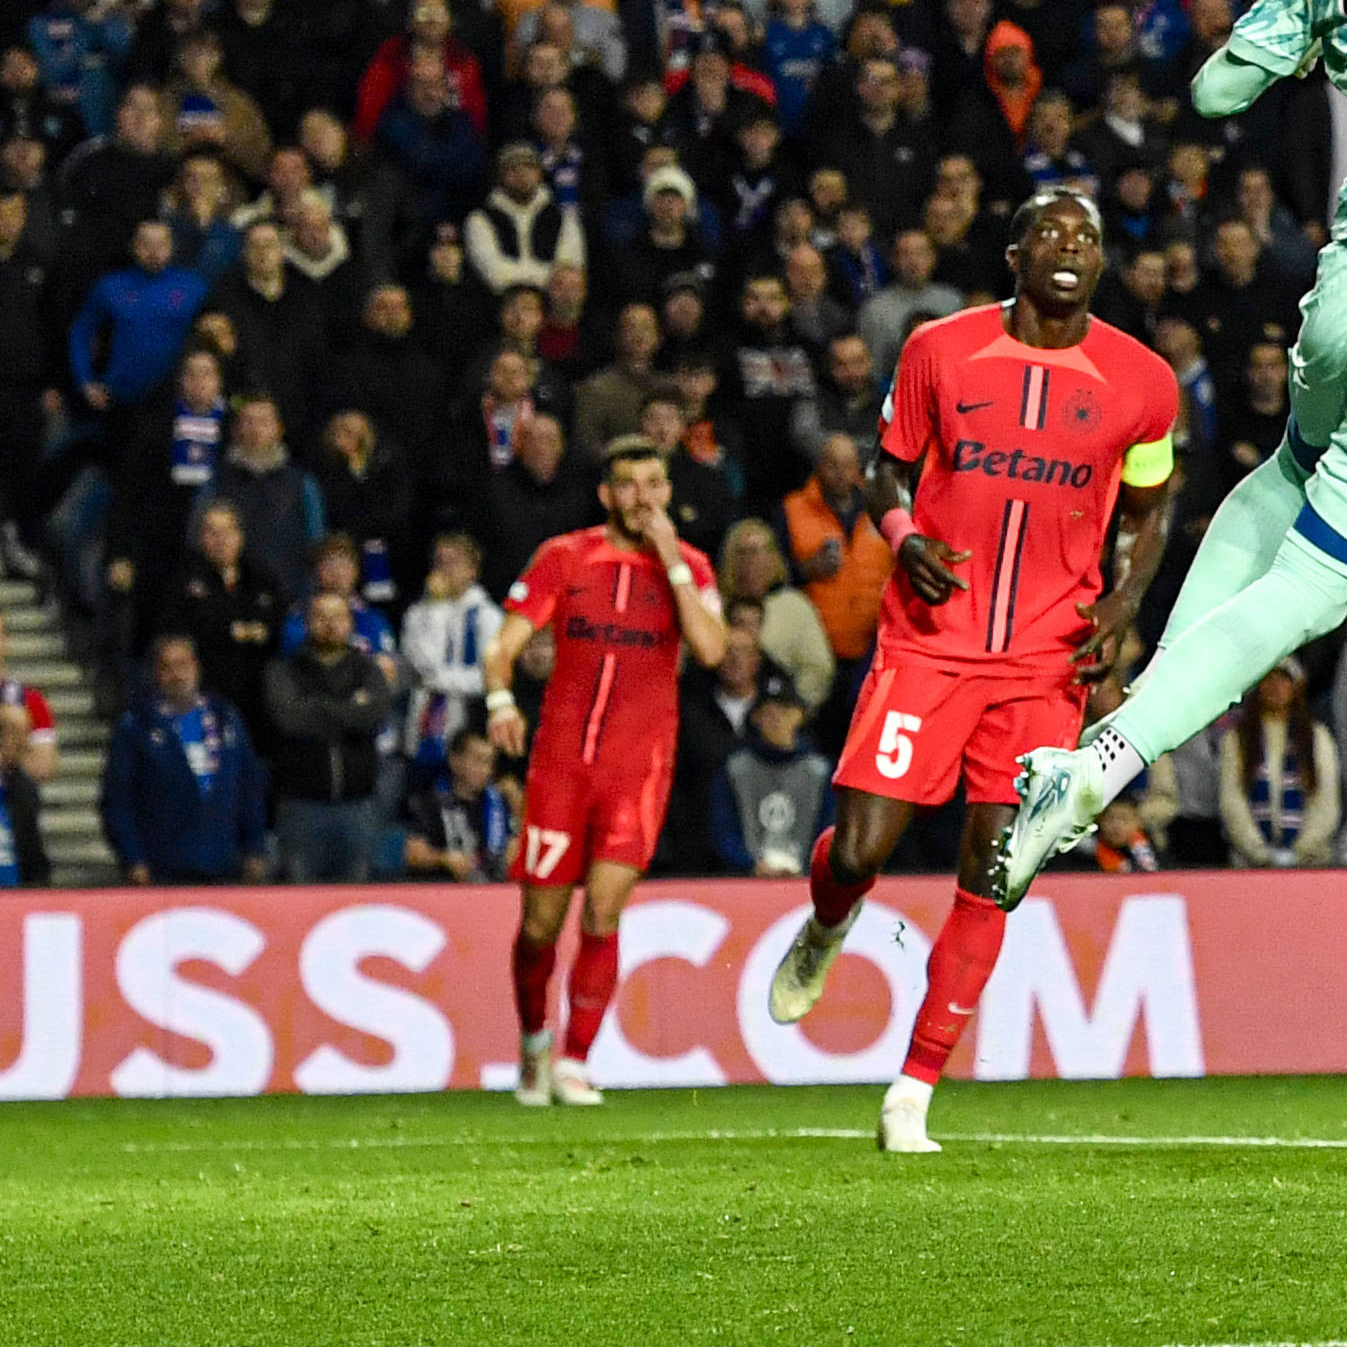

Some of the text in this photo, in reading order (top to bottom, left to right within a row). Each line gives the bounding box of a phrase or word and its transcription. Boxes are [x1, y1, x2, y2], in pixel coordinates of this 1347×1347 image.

[952, 438, 1093, 489] Betano
[875, 709, 923, 779] 5
[524, 825, 571, 880] 17
